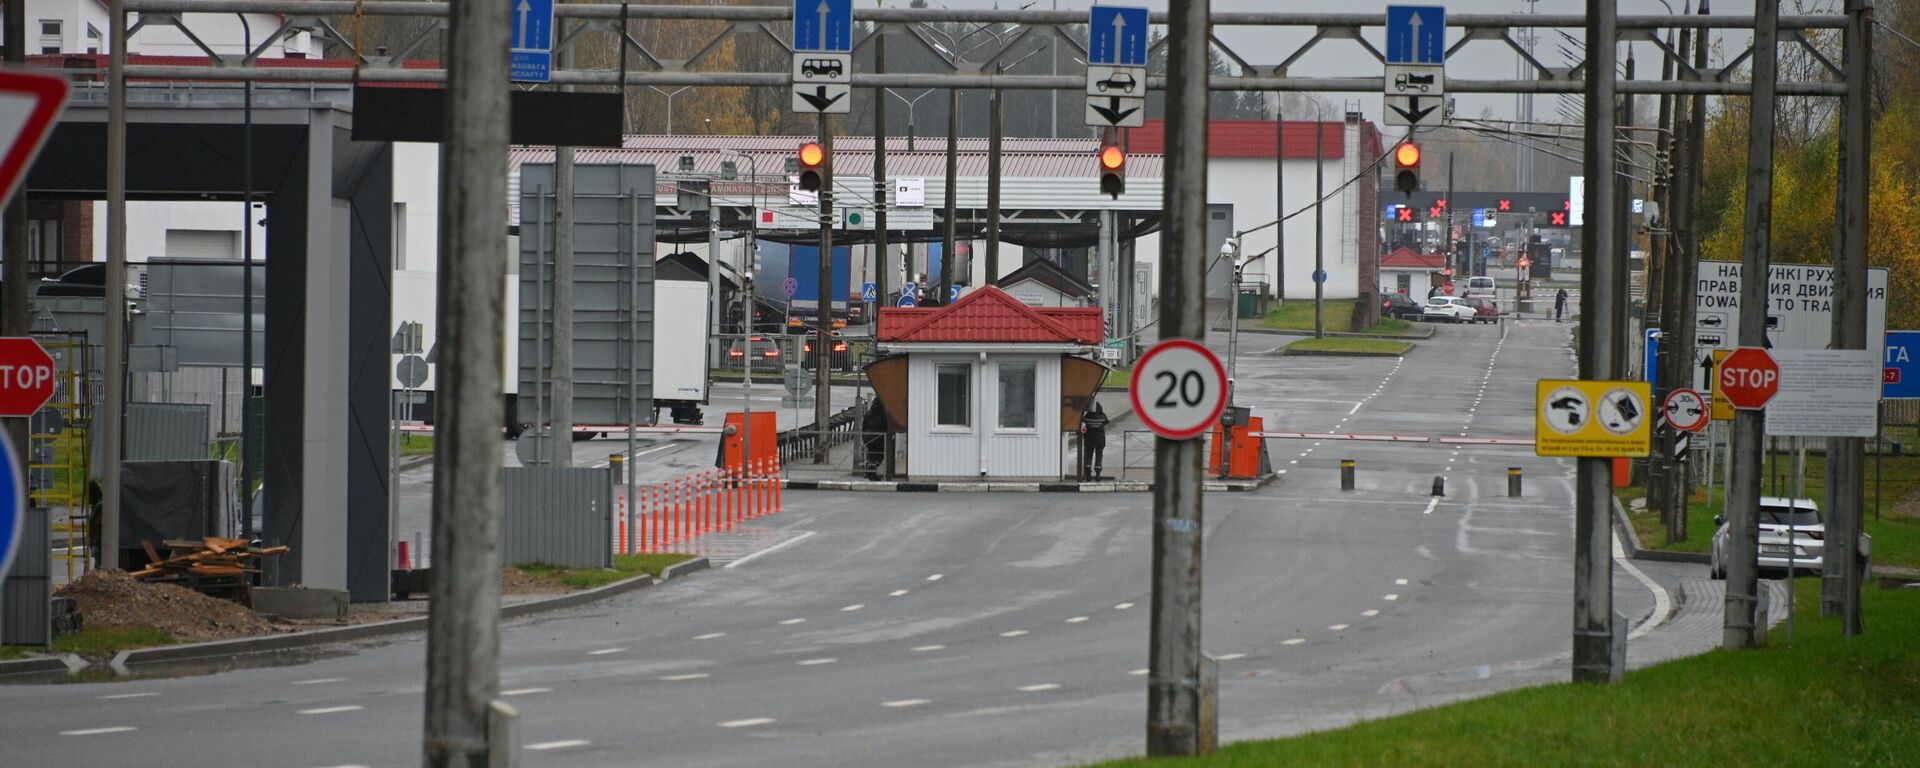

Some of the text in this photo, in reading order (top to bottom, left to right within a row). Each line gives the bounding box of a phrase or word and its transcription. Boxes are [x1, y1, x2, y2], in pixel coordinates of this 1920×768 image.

[710, 182, 757, 193] AMINATION
[1806, 269, 1835, 281] РУХ
[1775, 298, 1795, 311] TO
[1887, 346, 1910, 363] ГА
[0, 364, 51, 390] TOP
[1723, 368, 1776, 389] STOP
[1154, 370, 1205, 408] 20
